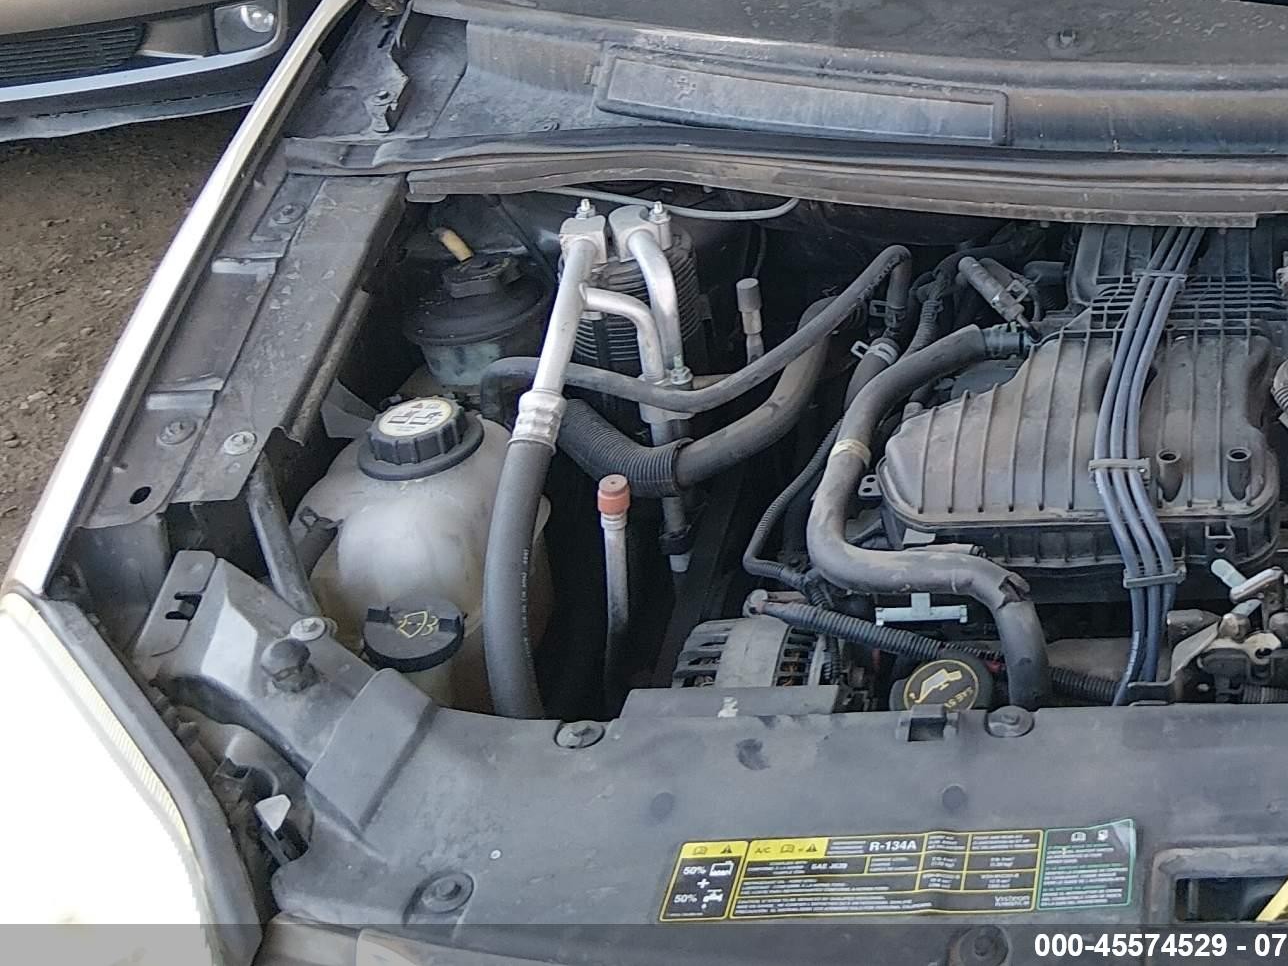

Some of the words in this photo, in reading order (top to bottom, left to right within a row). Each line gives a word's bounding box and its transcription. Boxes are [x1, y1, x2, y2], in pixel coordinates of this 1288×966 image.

[754, 844, 772, 855] A/C
[867, 838, 918, 853] R-134A
[682, 864, 706, 877] 50%
[673, 892, 698, 905] 50%
